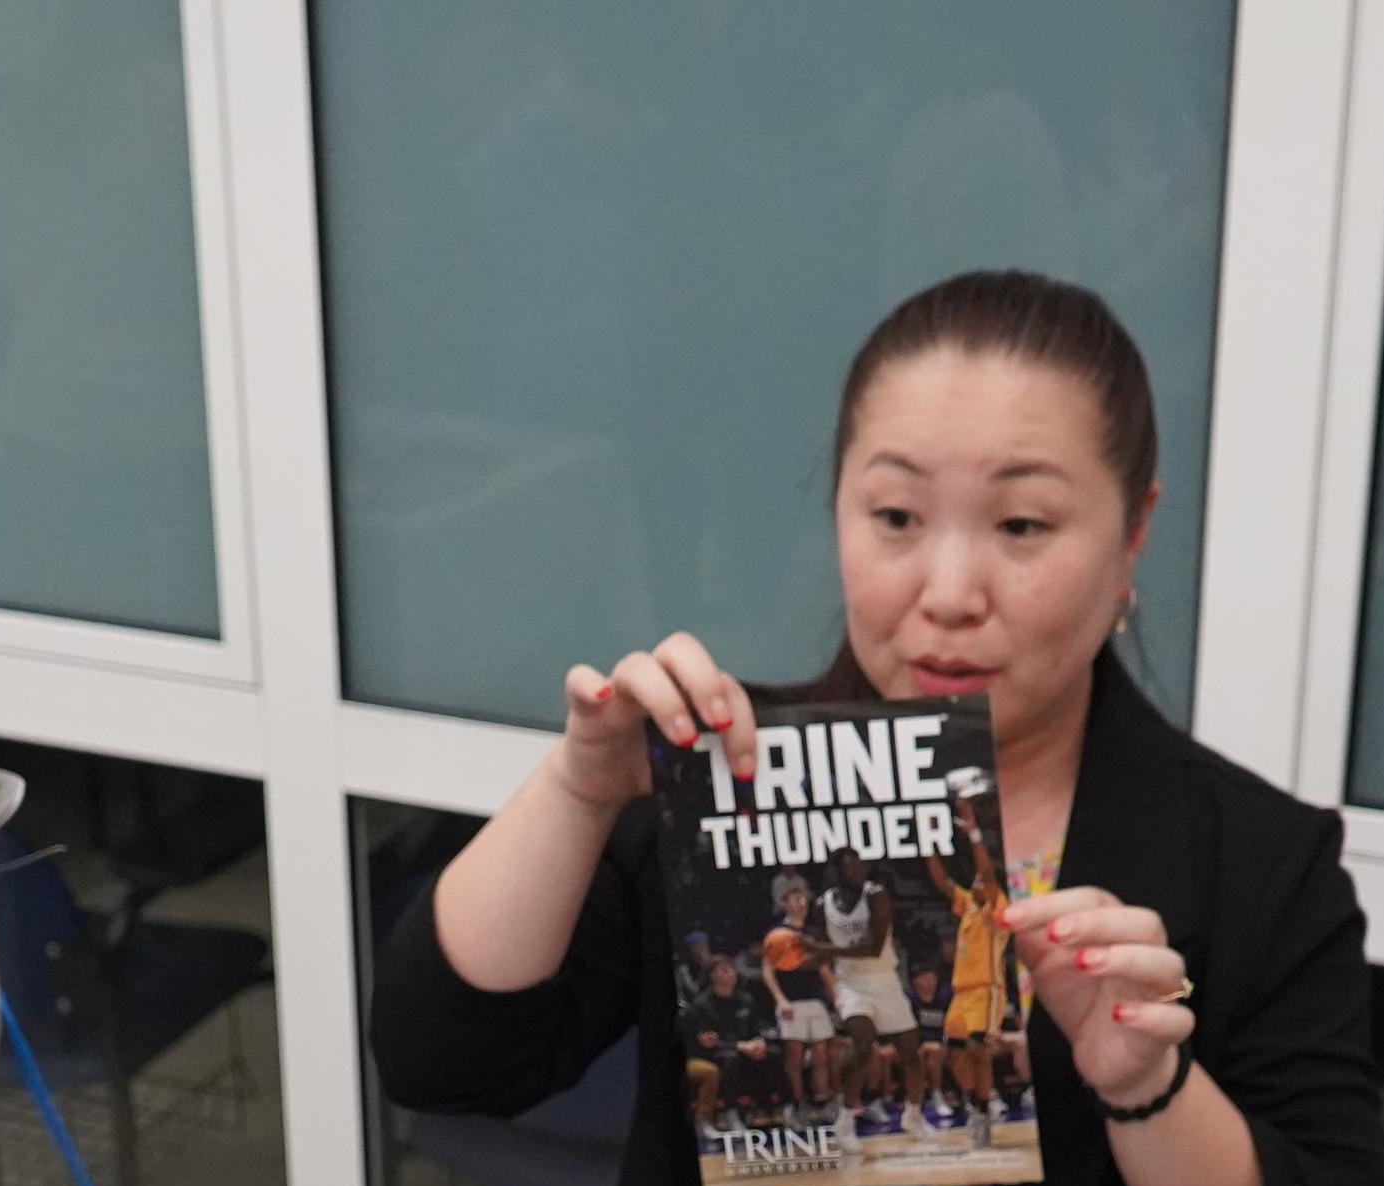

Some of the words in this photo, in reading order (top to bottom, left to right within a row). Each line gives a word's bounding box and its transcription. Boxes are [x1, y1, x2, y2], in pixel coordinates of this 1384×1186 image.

[693, 715, 947, 813] TRINE
[700, 802, 955, 869] THUNDER
[715, 1125, 842, 1164] TRINE
